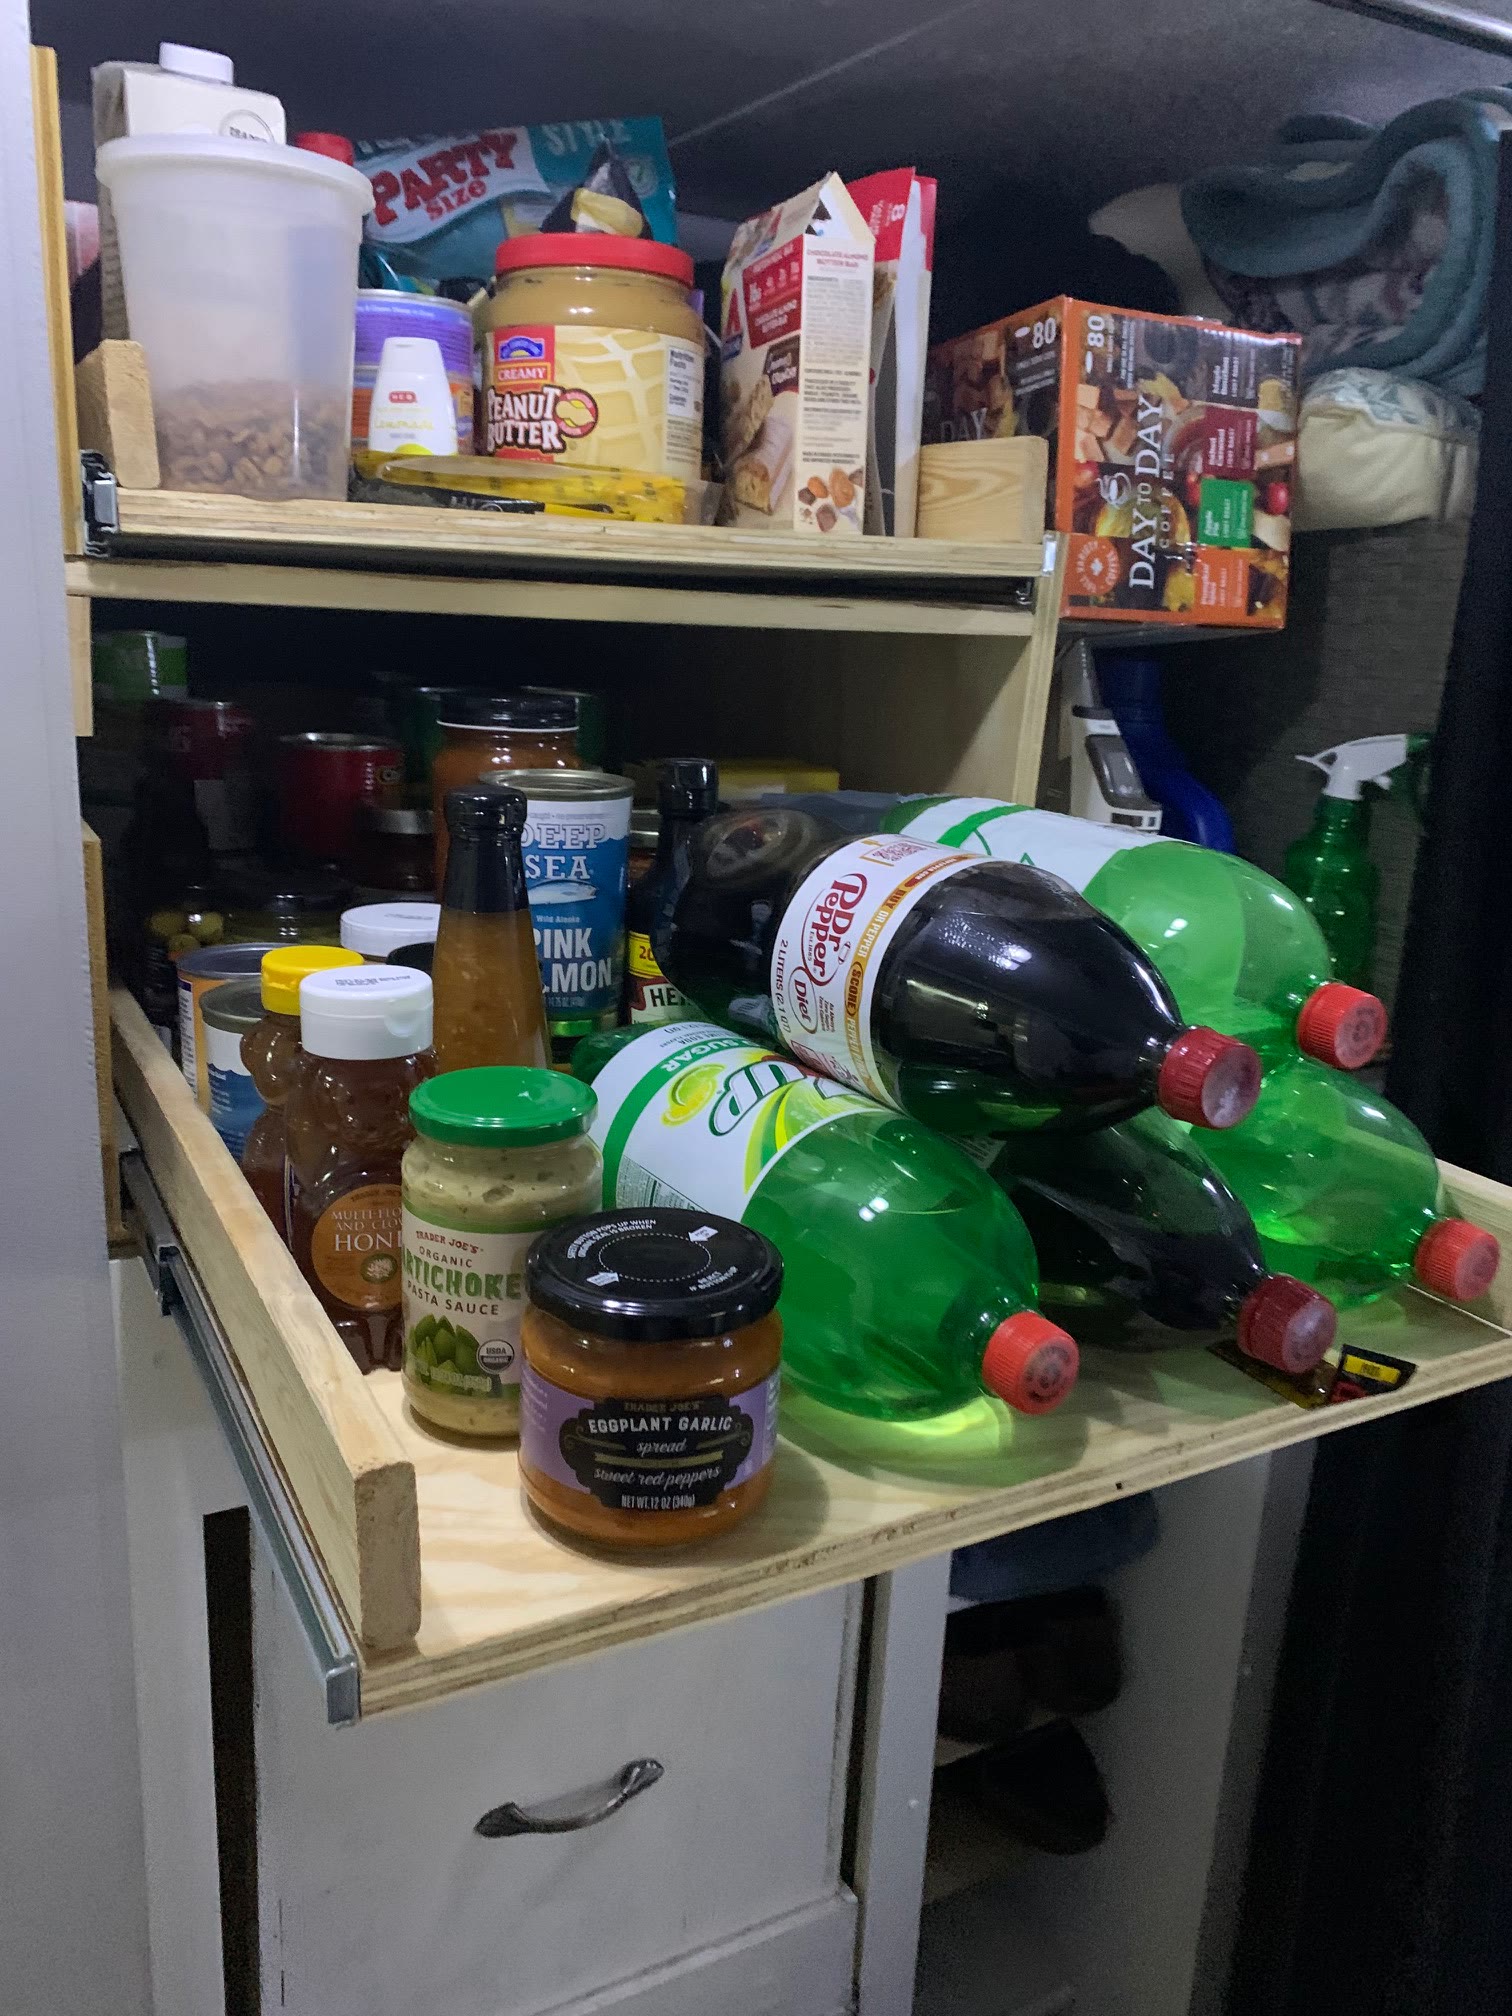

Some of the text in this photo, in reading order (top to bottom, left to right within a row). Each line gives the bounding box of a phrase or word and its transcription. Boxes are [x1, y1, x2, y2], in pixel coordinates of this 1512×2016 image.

[368, 132, 518, 227] PARTY
[1033, 317, 1056, 348] 80
[1087, 315, 1105, 348] 80
[498, 367, 547, 381] CREAMY
[488, 386, 561, 421] PEANUT
[1129, 394, 1163, 589] DAY TO DAY
[1159, 452, 1175, 549] COFFEE
[521, 822, 606, 850] DEEP
[525, 854, 591, 879] SEA
[882, 887, 907, 909] BUY
[536, 915, 553, 923] Wild
[811, 873, 868, 977] Pepper
[829, 908, 855, 951] Dr
[534, 927, 593, 959] PINK
[780, 939, 789, 948] 2
[857, 922, 881, 958] PEPPER
[775, 950, 786, 991] LITERS
[794, 979, 812, 1023] Diet
[846, 969, 862, 1010] SCORE
[660, 1039, 739, 1073] SUGAR
[336, 1222, 364, 1231] AND
[416, 1230, 446, 1244] TRADER
[596, 1222, 617, 1233] POPS
[616, 1220, 629, 1228] UP
[629, 1218, 656, 1226] WHEN
[617, 1223, 653, 1233] BROKEN
[419, 1245, 473, 1268] ORGANIC
[407, 1279, 499, 1316] PASTA SAUCE
[486, 1346, 507, 1355] USDA
[588, 1415, 734, 1434] EGGPLANT GARLIC
[636, 1438, 688, 1458] spread
[593, 1465, 721, 1492] sweet red peppers
[621, 1494, 636, 1508] NET
[661, 1497, 671, 1510] OZ
